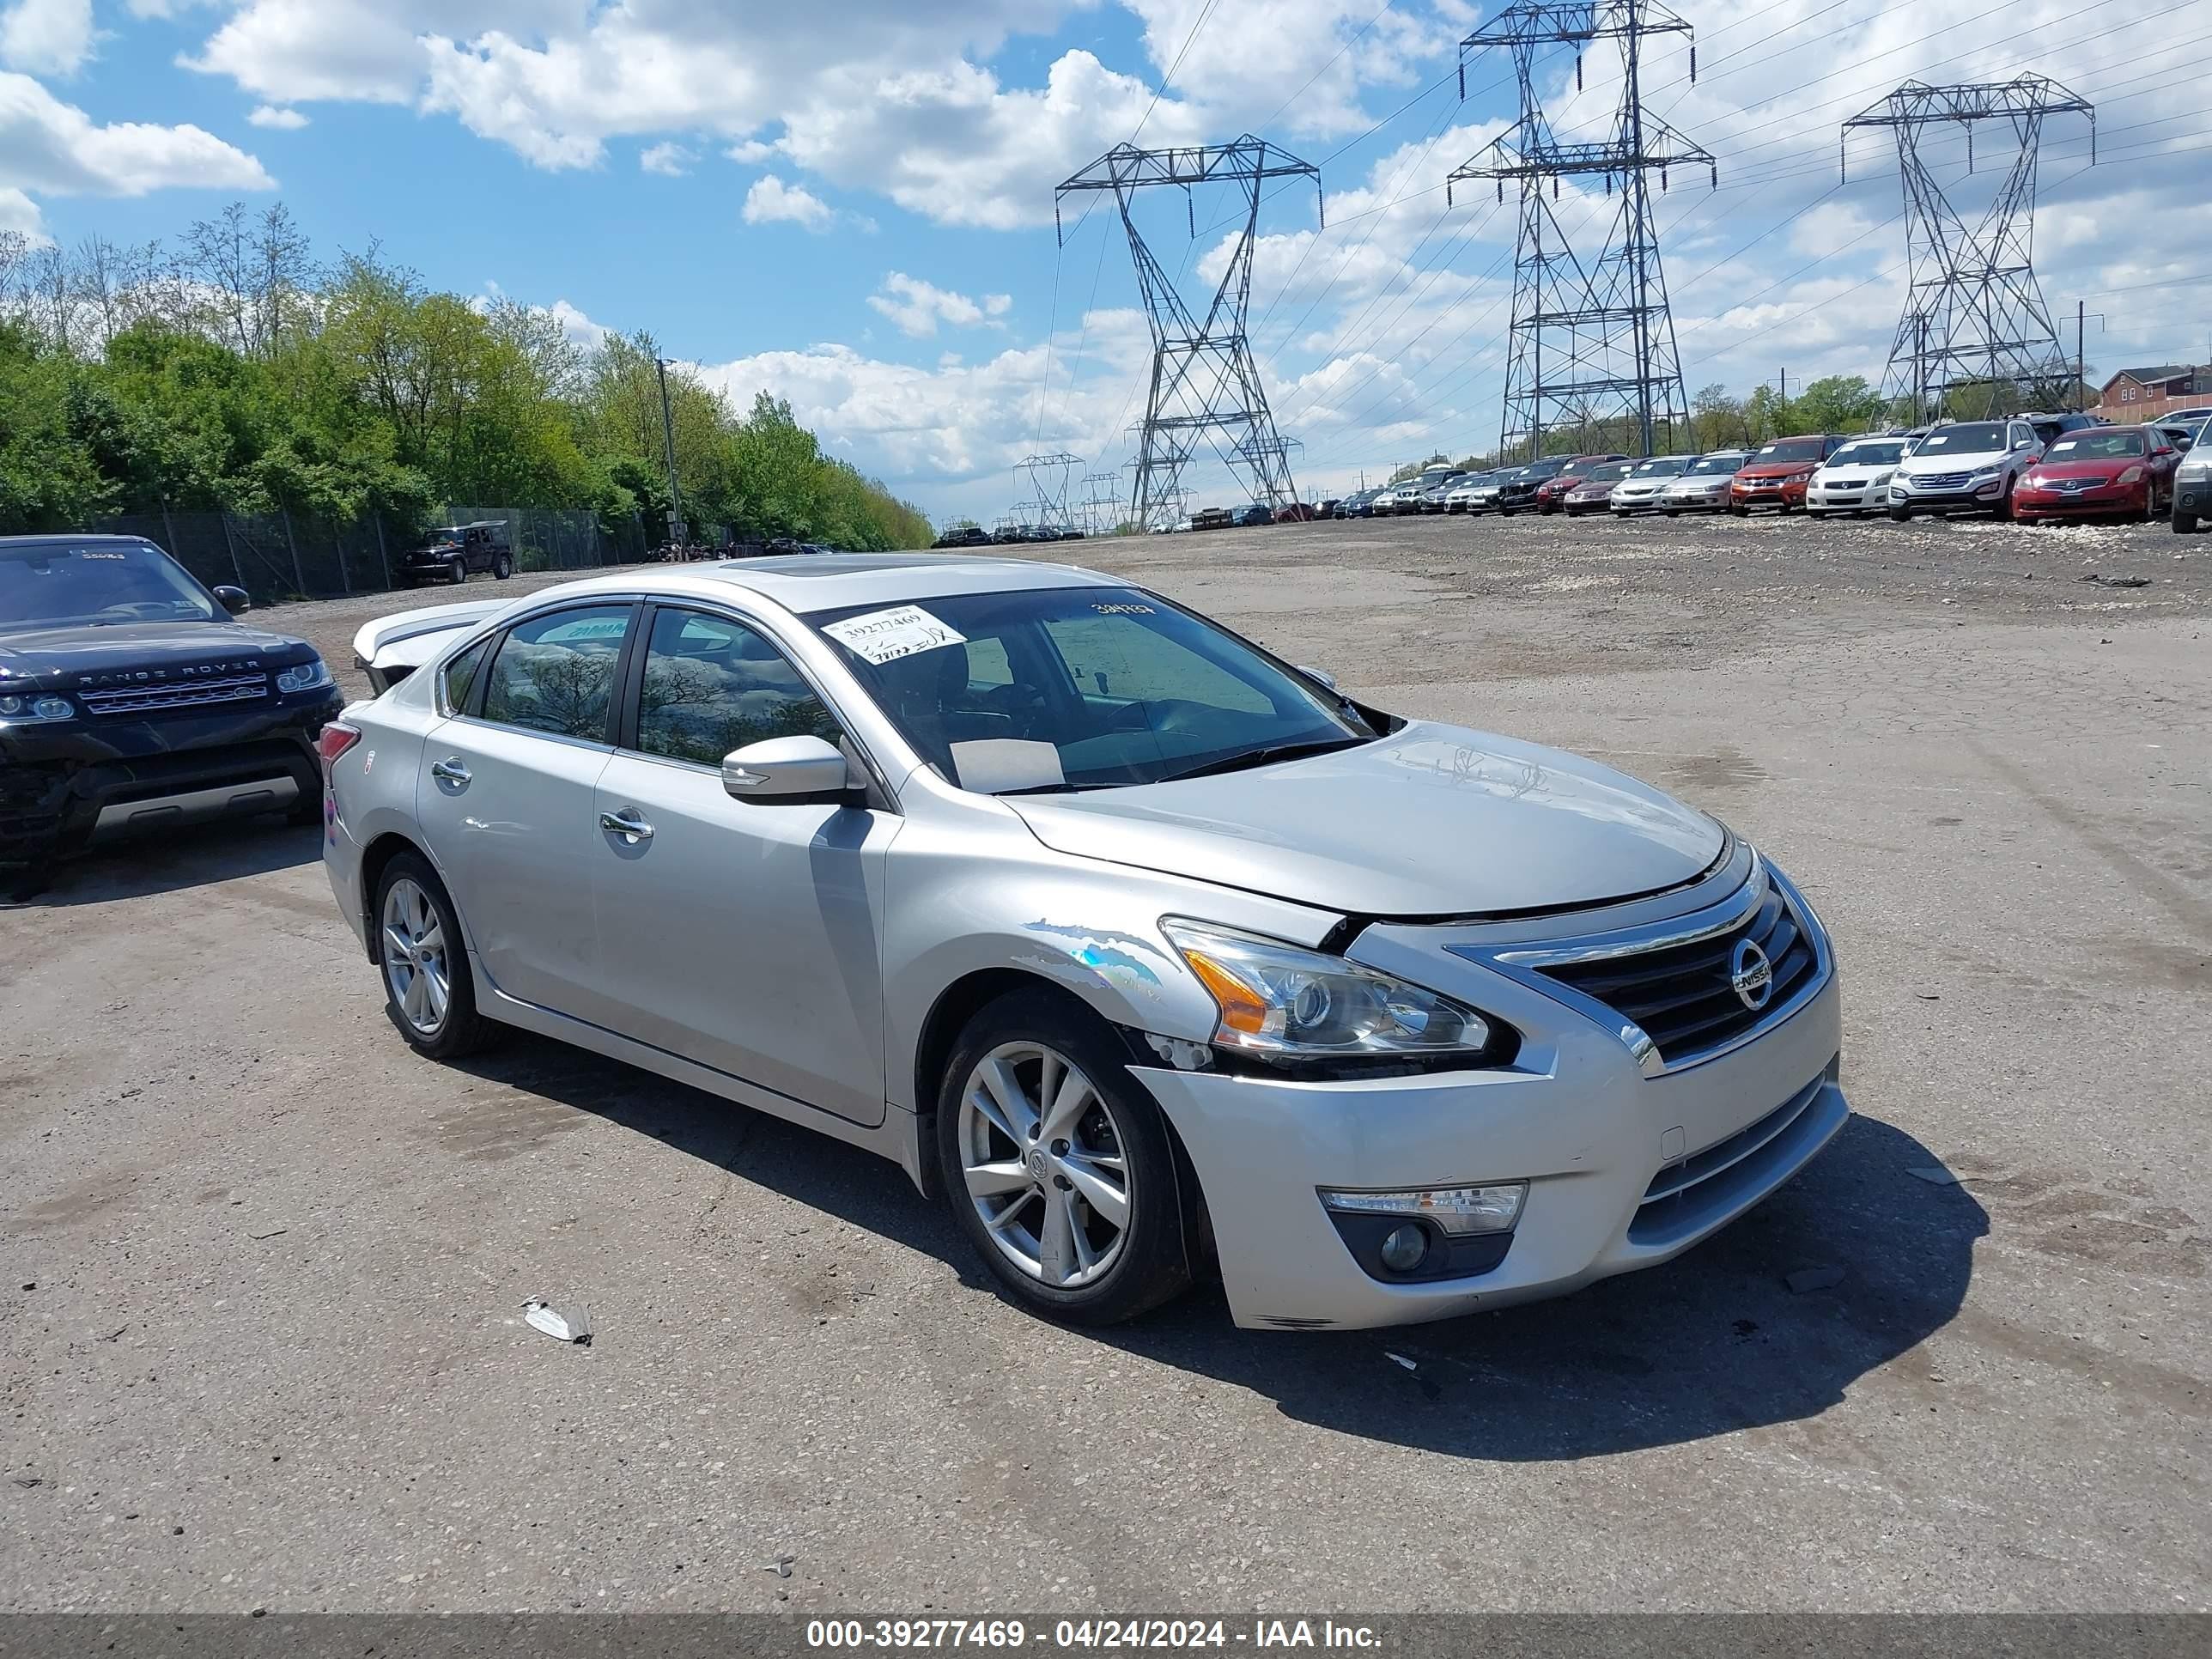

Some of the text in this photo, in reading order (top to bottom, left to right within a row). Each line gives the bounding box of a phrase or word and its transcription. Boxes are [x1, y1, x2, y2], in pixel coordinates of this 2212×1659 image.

[844, 614, 921, 639] 39277469
[79, 660, 259, 684] RANGE ROVER
